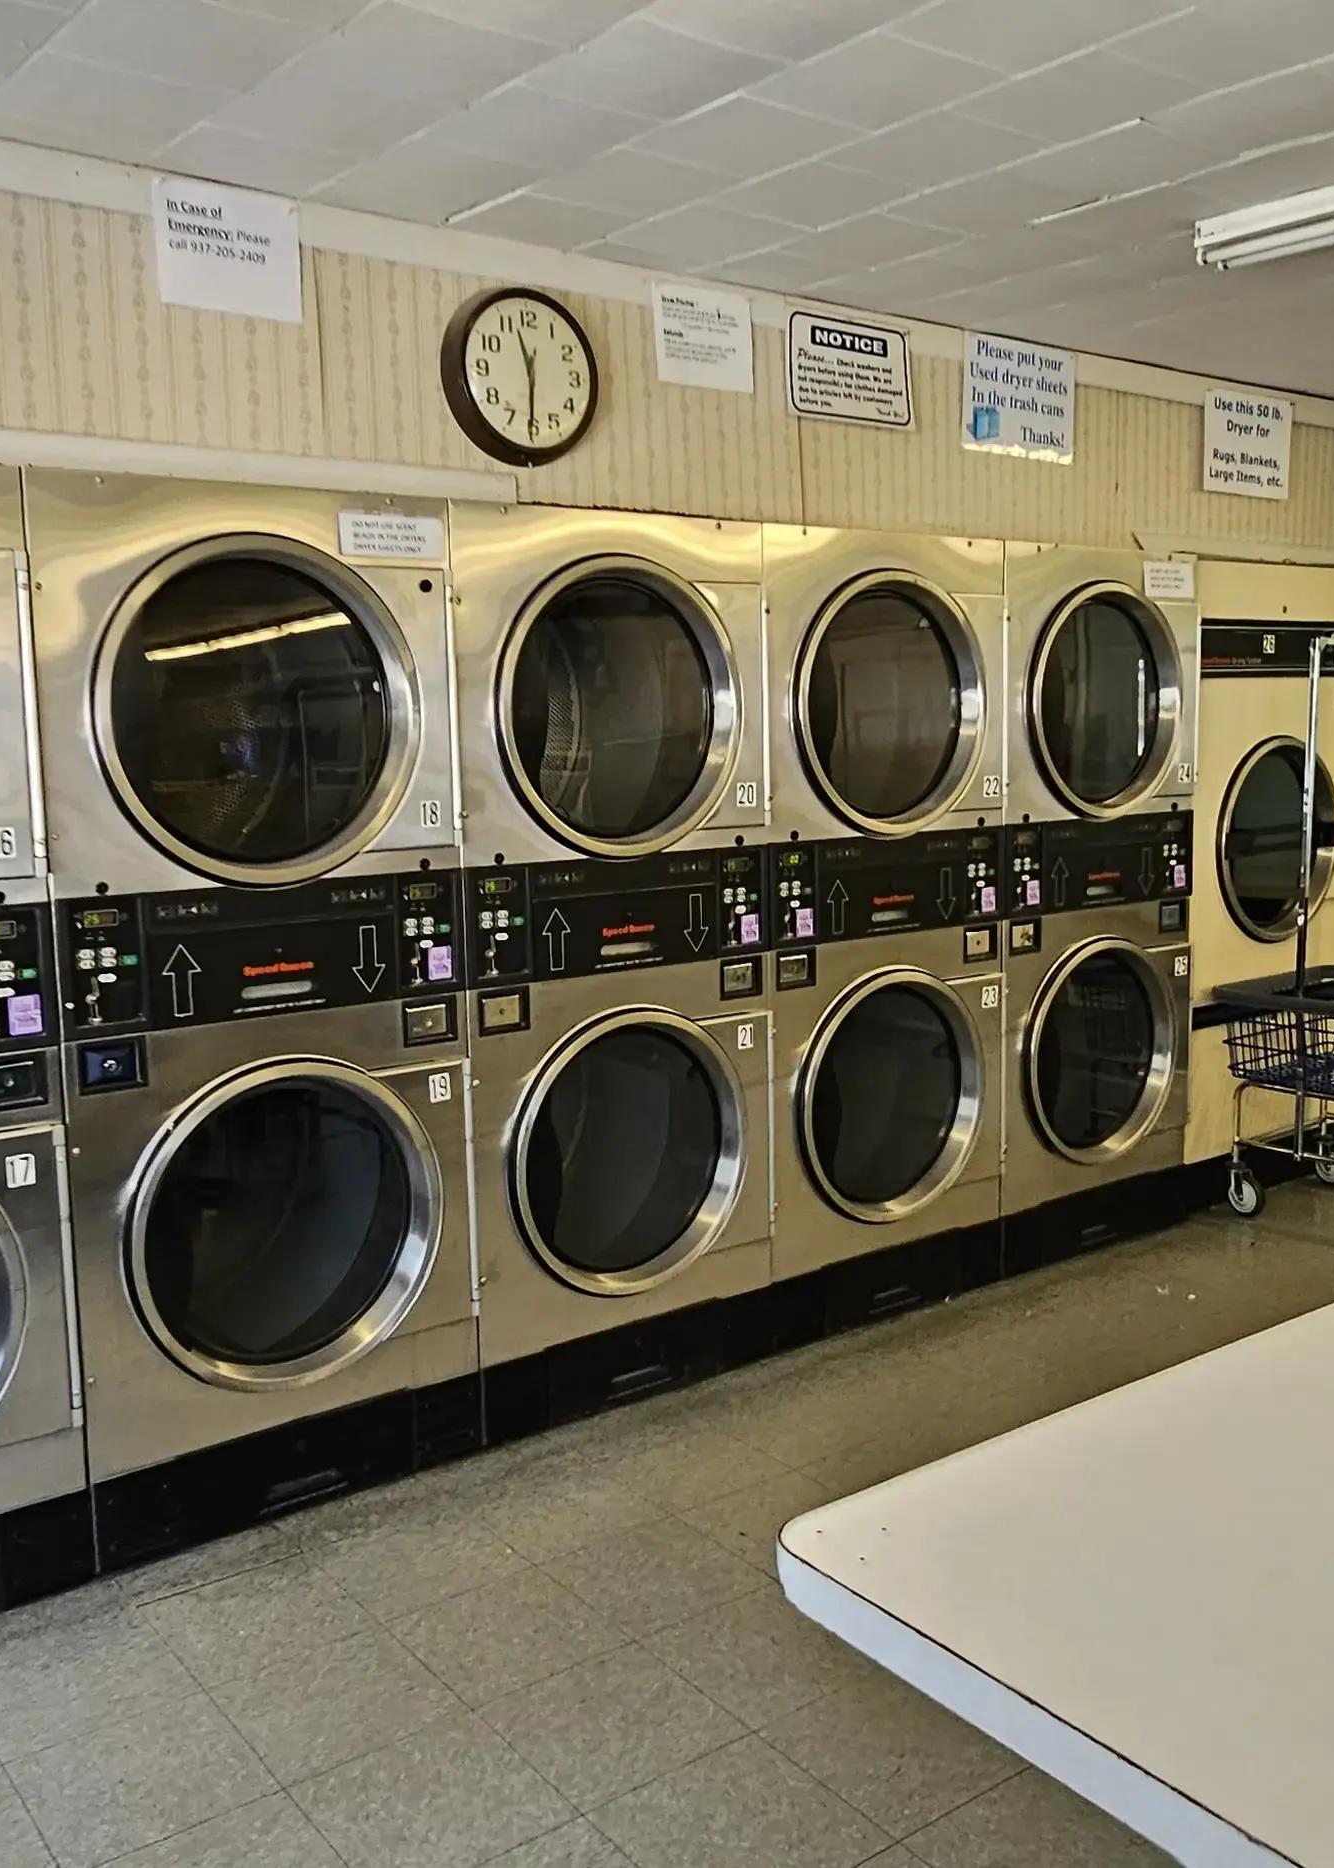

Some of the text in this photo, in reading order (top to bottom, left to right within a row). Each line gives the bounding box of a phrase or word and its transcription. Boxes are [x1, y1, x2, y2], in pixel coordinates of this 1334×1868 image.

[167, 199, 222, 219] In Case of
[237, 230, 271, 246] Please
[169, 239, 266, 265] call 937-205-2409
[499, 315, 513, 334] 11
[520, 309, 538, 329] 12
[549, 321, 555, 340] 1
[481, 333, 501, 353] 10
[814, 328, 884, 354] NOTICE
[561, 344, 573, 362] 2
[977, 339, 1064, 372] Please put your
[476, 358, 490, 377] 9
[569, 371, 581, 389] 3
[970, 361, 1068, 396] Used dryer sheets
[486, 387, 500, 405] 8
[563, 397, 575, 415] 4
[972, 386, 1064, 418] In the trash cans
[504, 408, 516, 425] 7
[1214, 397, 1283, 421] Use this 50 lb.
[527, 418, 540, 437] 6
[548, 413, 560, 430] 5
[1227, 419, 1270, 438] Dryer for
[1021, 425, 1065, 448] Thanks!
[1213, 448, 1280, 471] Rugs, Blankets,
[1209, 466, 1283, 488] Large Items, etc.
[1179, 765, 1191, 781] 24
[739, 784, 755, 805] 20
[985, 776, 999, 796] 22
[422, 802, 439, 826] 18
[1176, 958, 1187, 974] 25
[983, 988, 997, 1006] 23
[740, 1027, 753, 1047] 21
[431, 1076, 449, 1099] 19
[8, 1158, 32, 1185] 17
